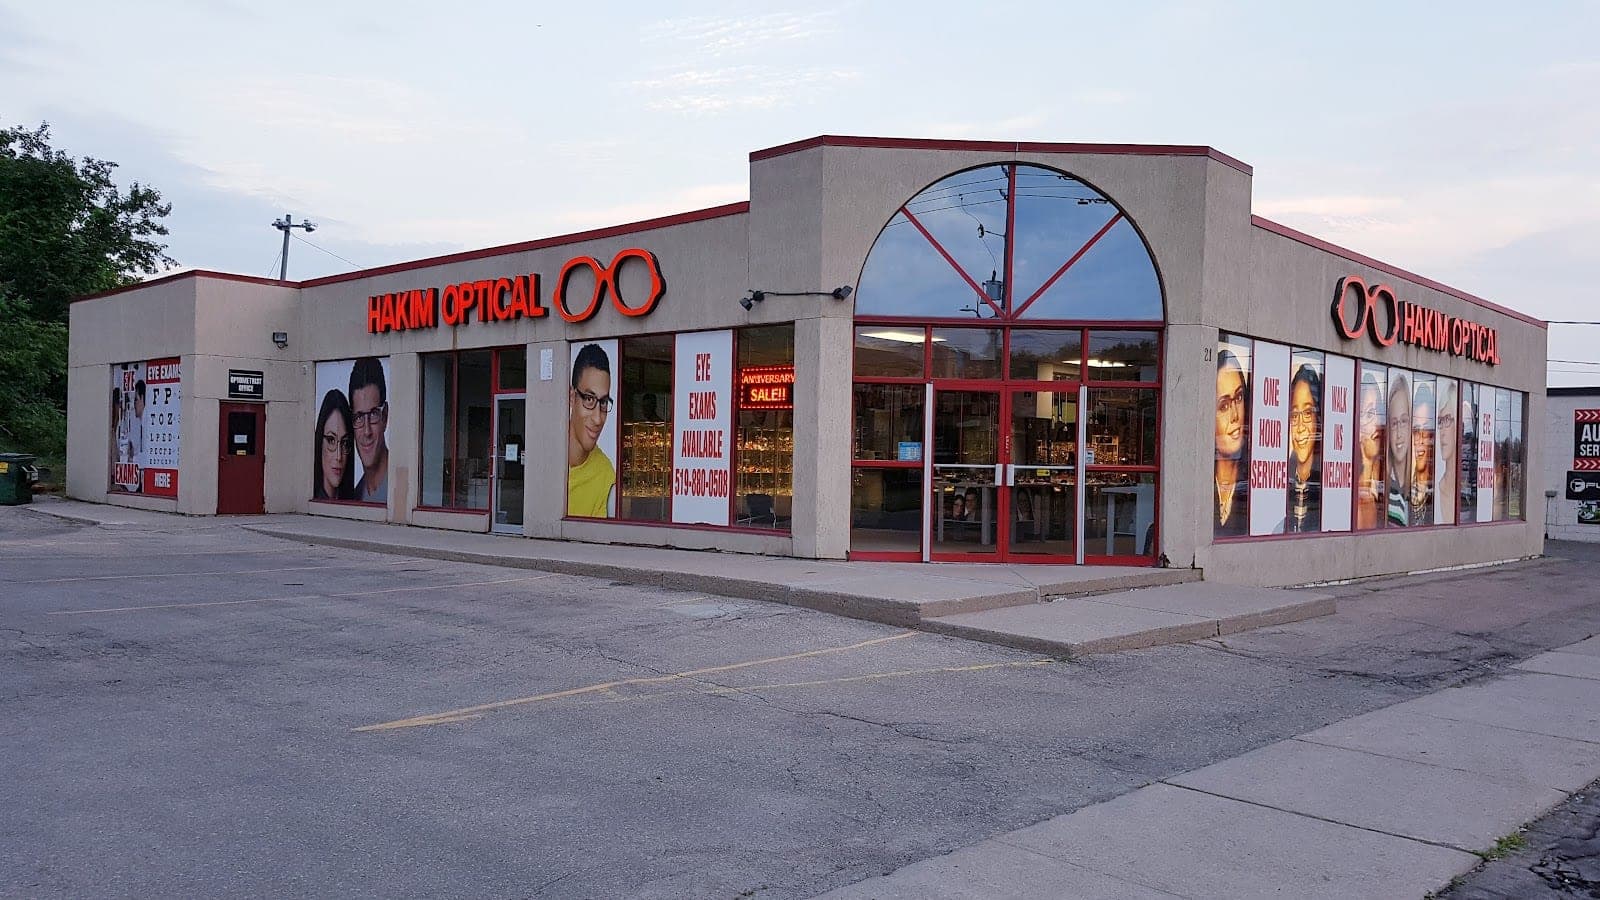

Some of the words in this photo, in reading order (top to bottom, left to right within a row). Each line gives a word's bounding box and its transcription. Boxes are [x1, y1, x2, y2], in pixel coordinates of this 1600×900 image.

[368, 288, 438, 333] HAKIM
[441, 273, 548, 327] OPTICAL
[1403, 301, 1449, 352] HAKIM
[1452, 317, 1501, 366] OPTICAL
[695, 353, 711, 382] EYE
[1204, 347, 1212, 362] 21
[123, 371, 135, 391] EYE
[148, 365, 160, 380] EYE
[743, 373, 795, 384] ANNIVERSARY
[689, 391, 717, 420] EXAMS
[750, 388, 786, 402] SALE!!
[1263, 377, 1280, 407] ONE
[1331, 385, 1348, 414] WALK
[1258, 418, 1282, 448] HOUR
[1333, 424, 1344, 450] INS
[1483, 413, 1491, 435] EYE
[1581, 423, 1600, 442] AU
[681, 430, 723, 458] AVAILABLE
[115, 464, 139, 485] EXAMS
[154, 472, 171, 488] HERE
[1251, 460, 1287, 489] SERVICE
[1323, 461, 1351, 489] WELCOME
